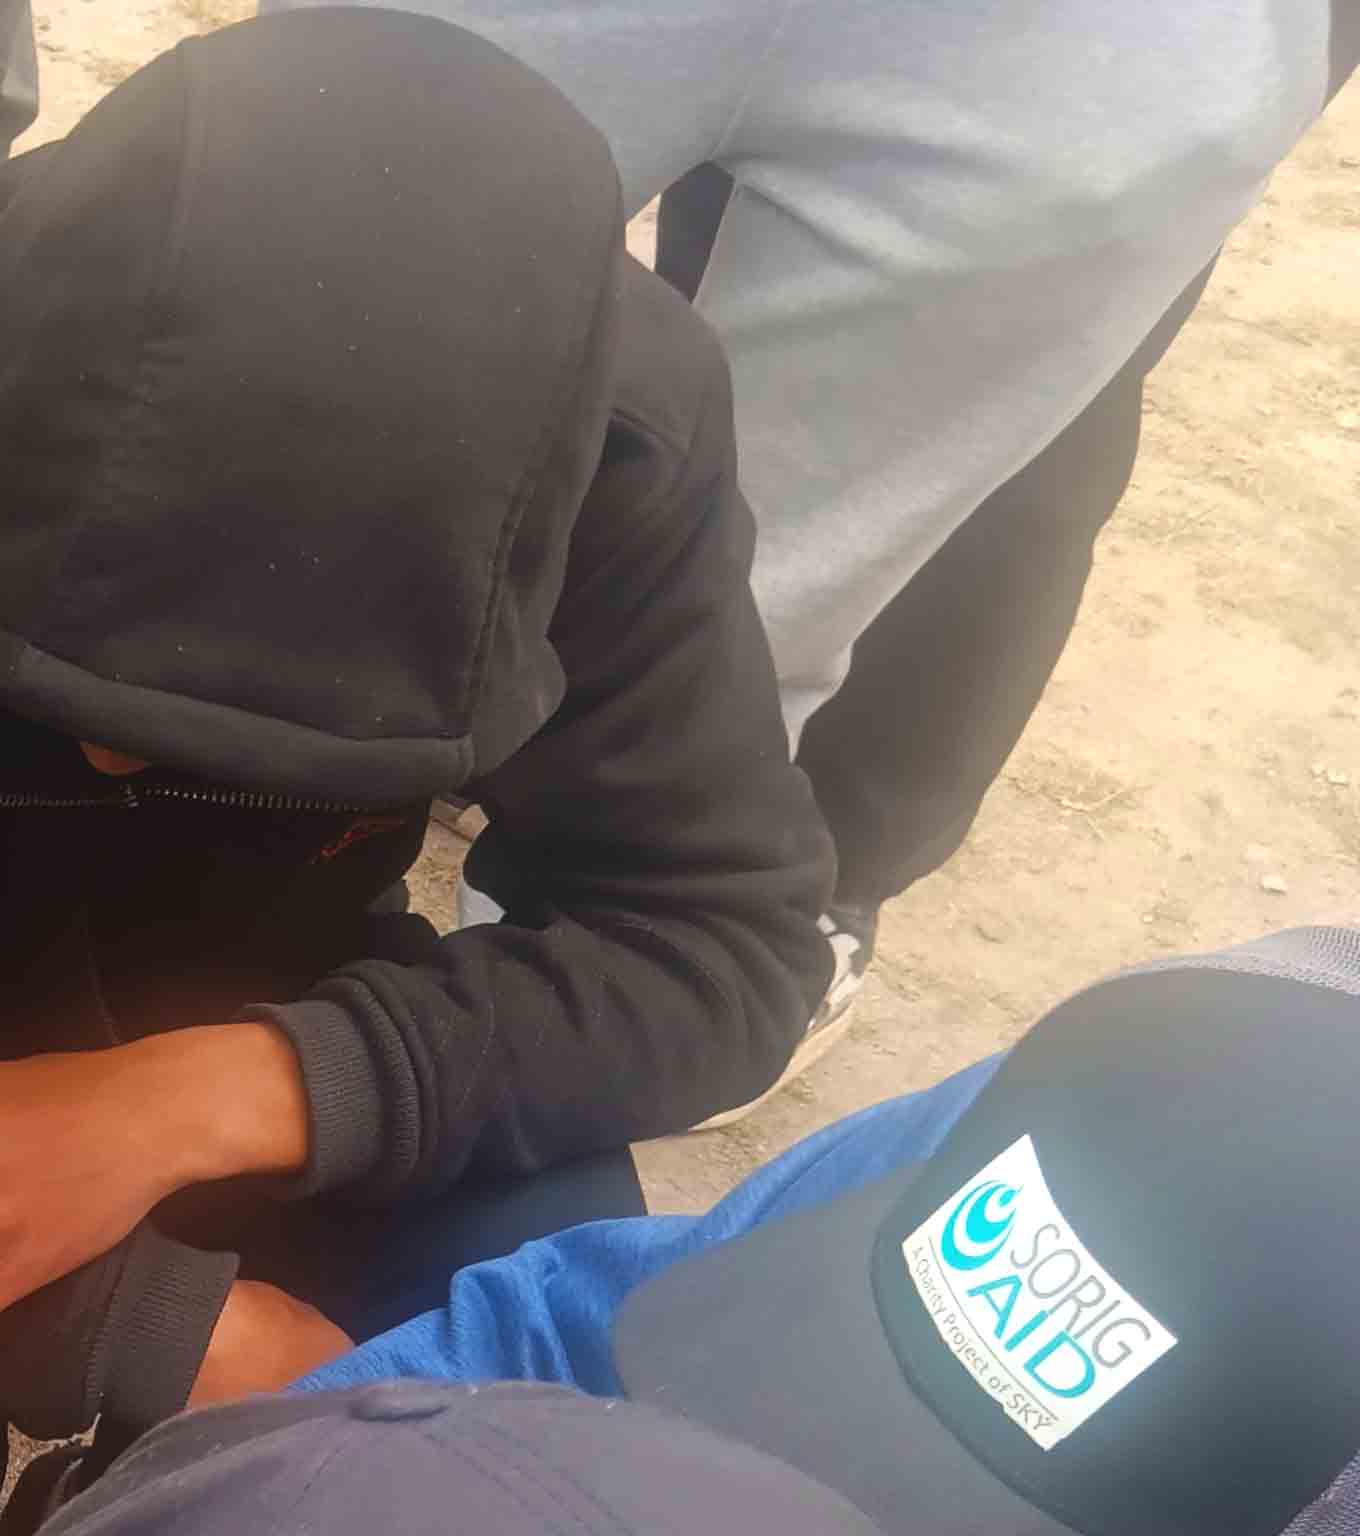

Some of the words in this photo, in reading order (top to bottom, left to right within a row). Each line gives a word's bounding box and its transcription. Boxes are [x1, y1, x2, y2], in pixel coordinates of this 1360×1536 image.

[914, 1257, 947, 1317] Charity
[942, 1313, 990, 1379] Project
[987, 1375, 1012, 1396] of
[1005, 1392, 1054, 1431] SKY
[966, 1274, 1097, 1399] AID
[1010, 1223, 1152, 1369] SORIG
